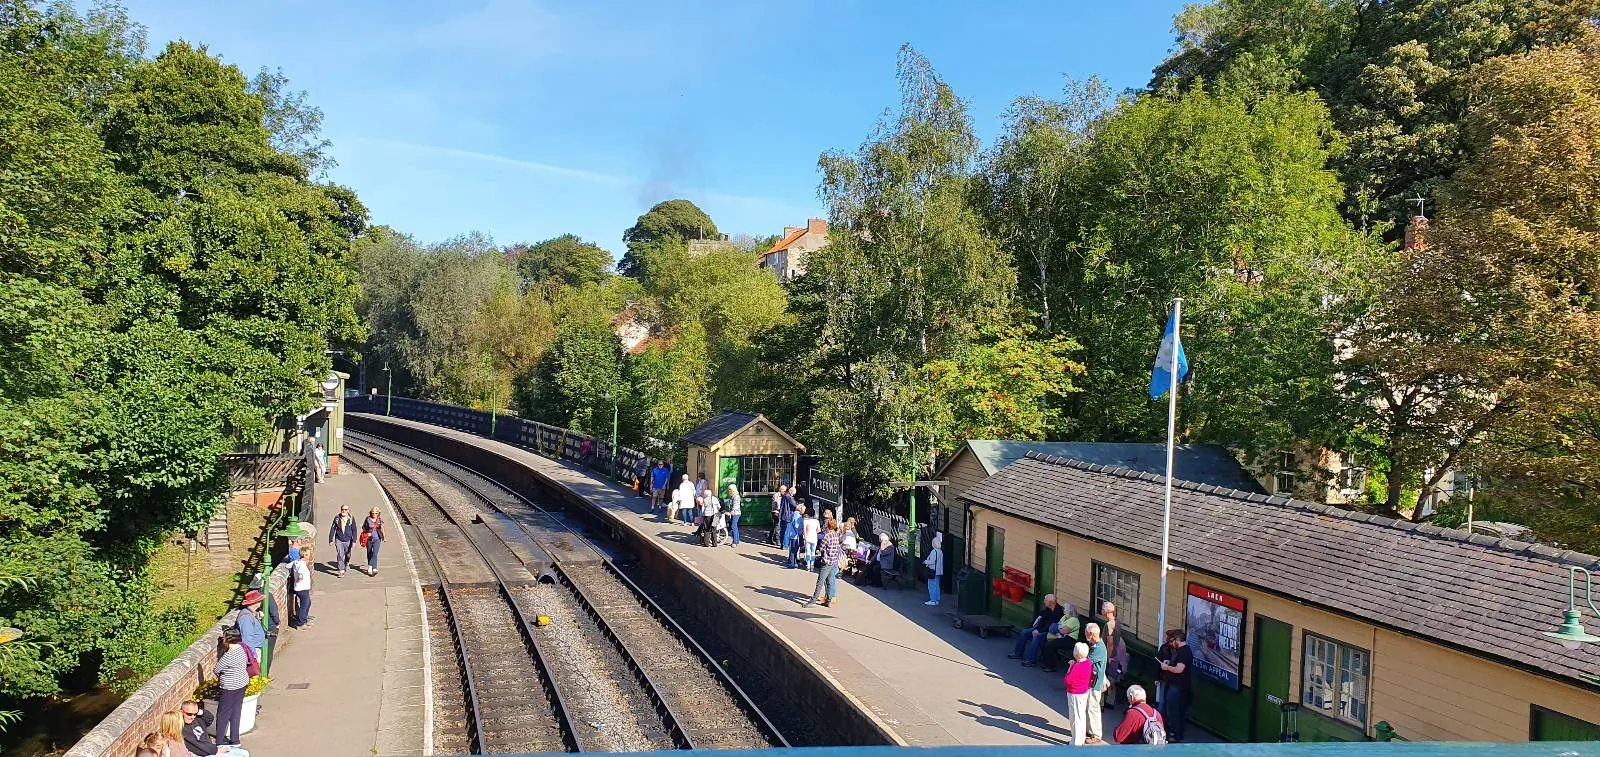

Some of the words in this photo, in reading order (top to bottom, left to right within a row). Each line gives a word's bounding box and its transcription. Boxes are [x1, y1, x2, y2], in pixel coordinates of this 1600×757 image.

[1219, 621, 1238, 640] YOUR
[1218, 635, 1237, 653] HELP!
[1208, 665, 1230, 681] APPEAL
